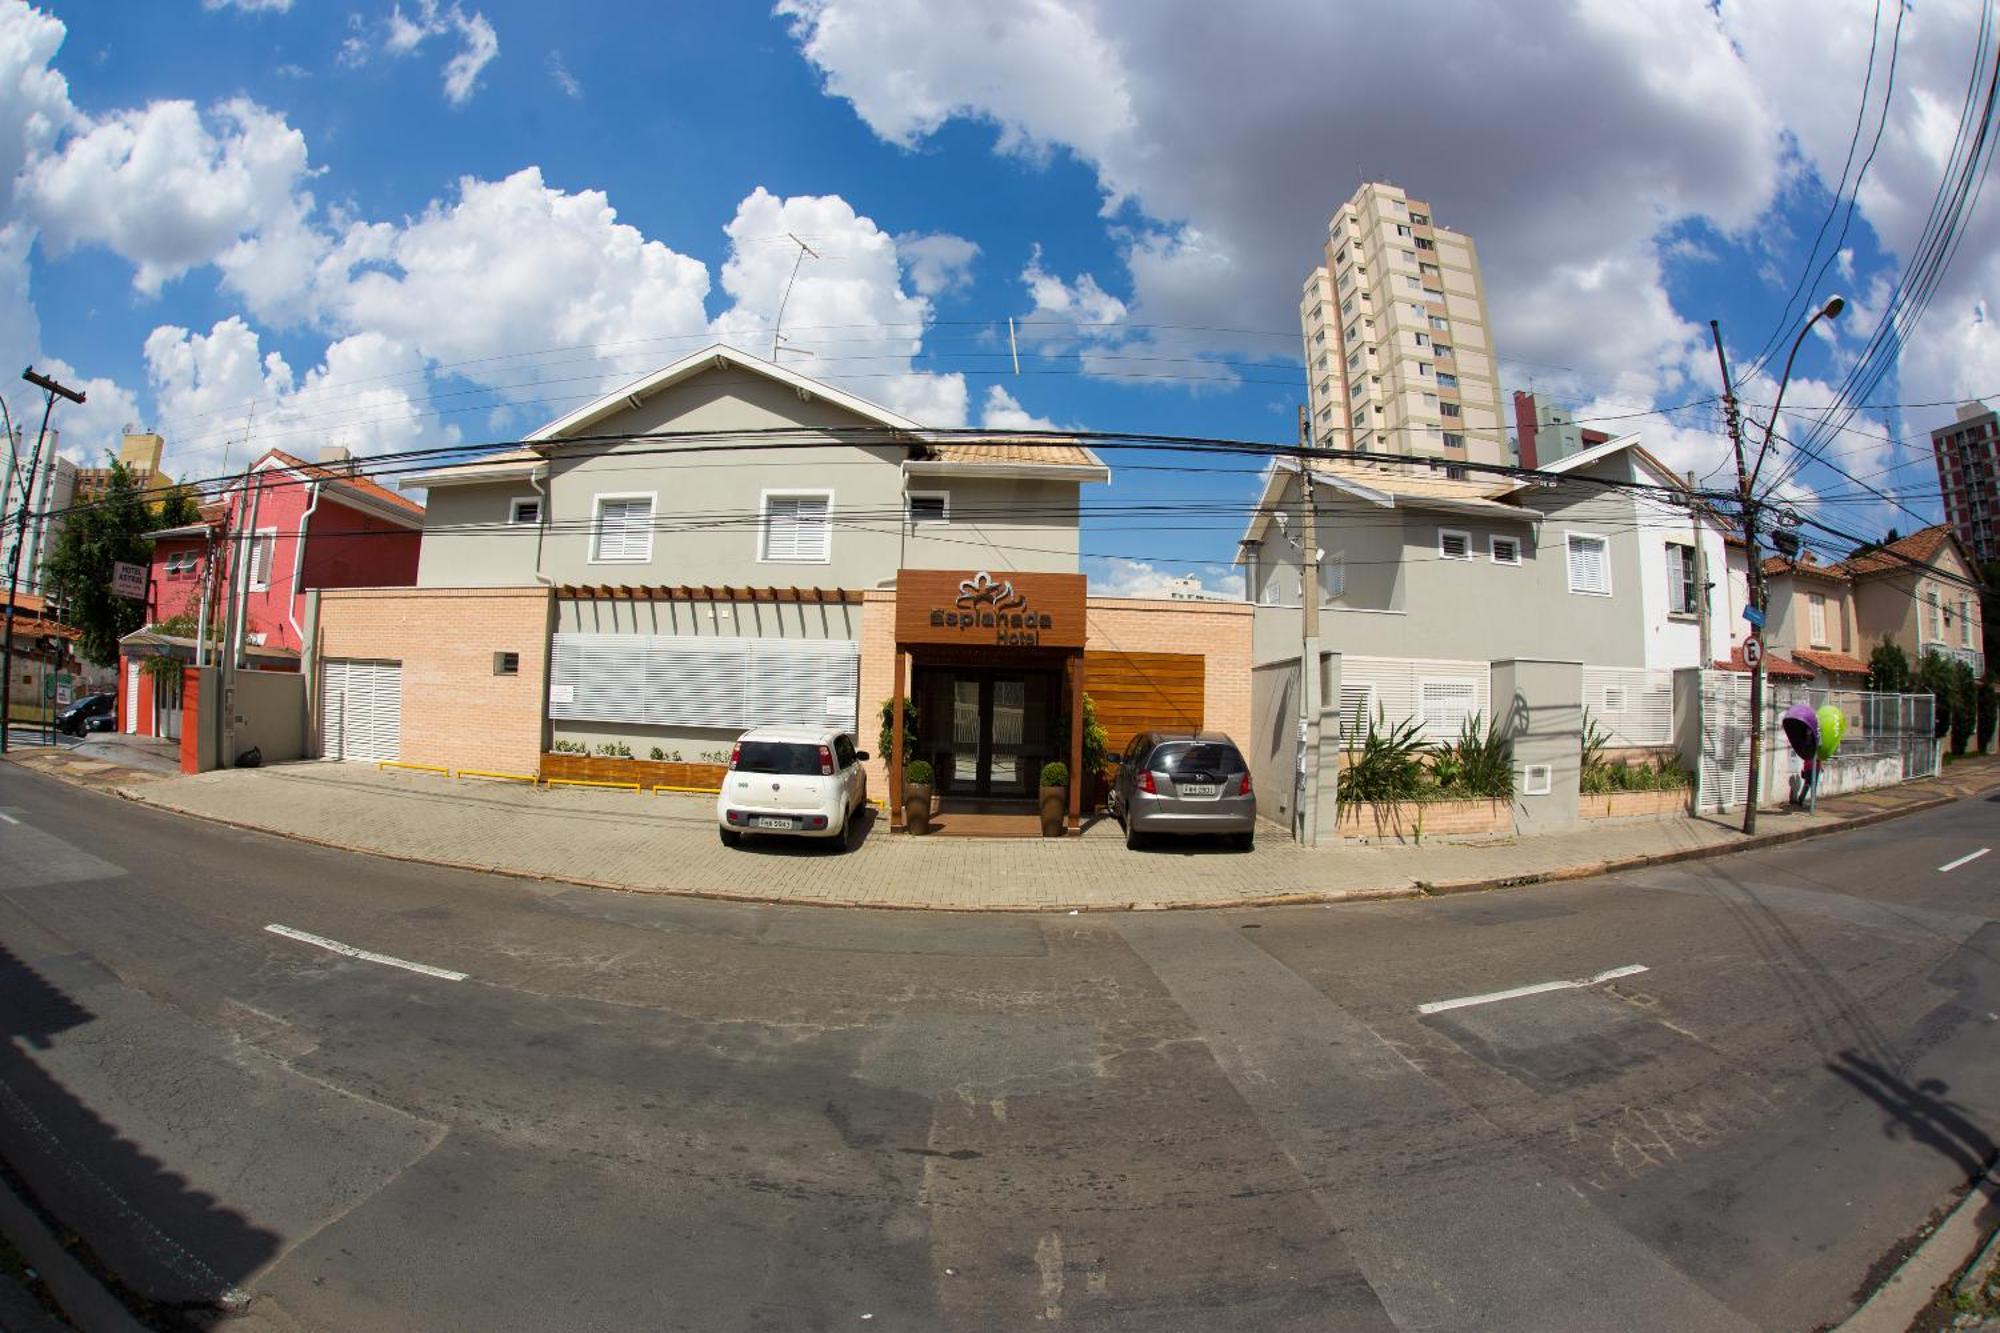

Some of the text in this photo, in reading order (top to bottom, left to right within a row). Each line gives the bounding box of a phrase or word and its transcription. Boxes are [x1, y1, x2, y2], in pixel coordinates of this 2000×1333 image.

[122, 565, 142, 576] HOTEL
[929, 607, 1052, 631] Esplanada
[996, 629, 1039, 646] Hotel
